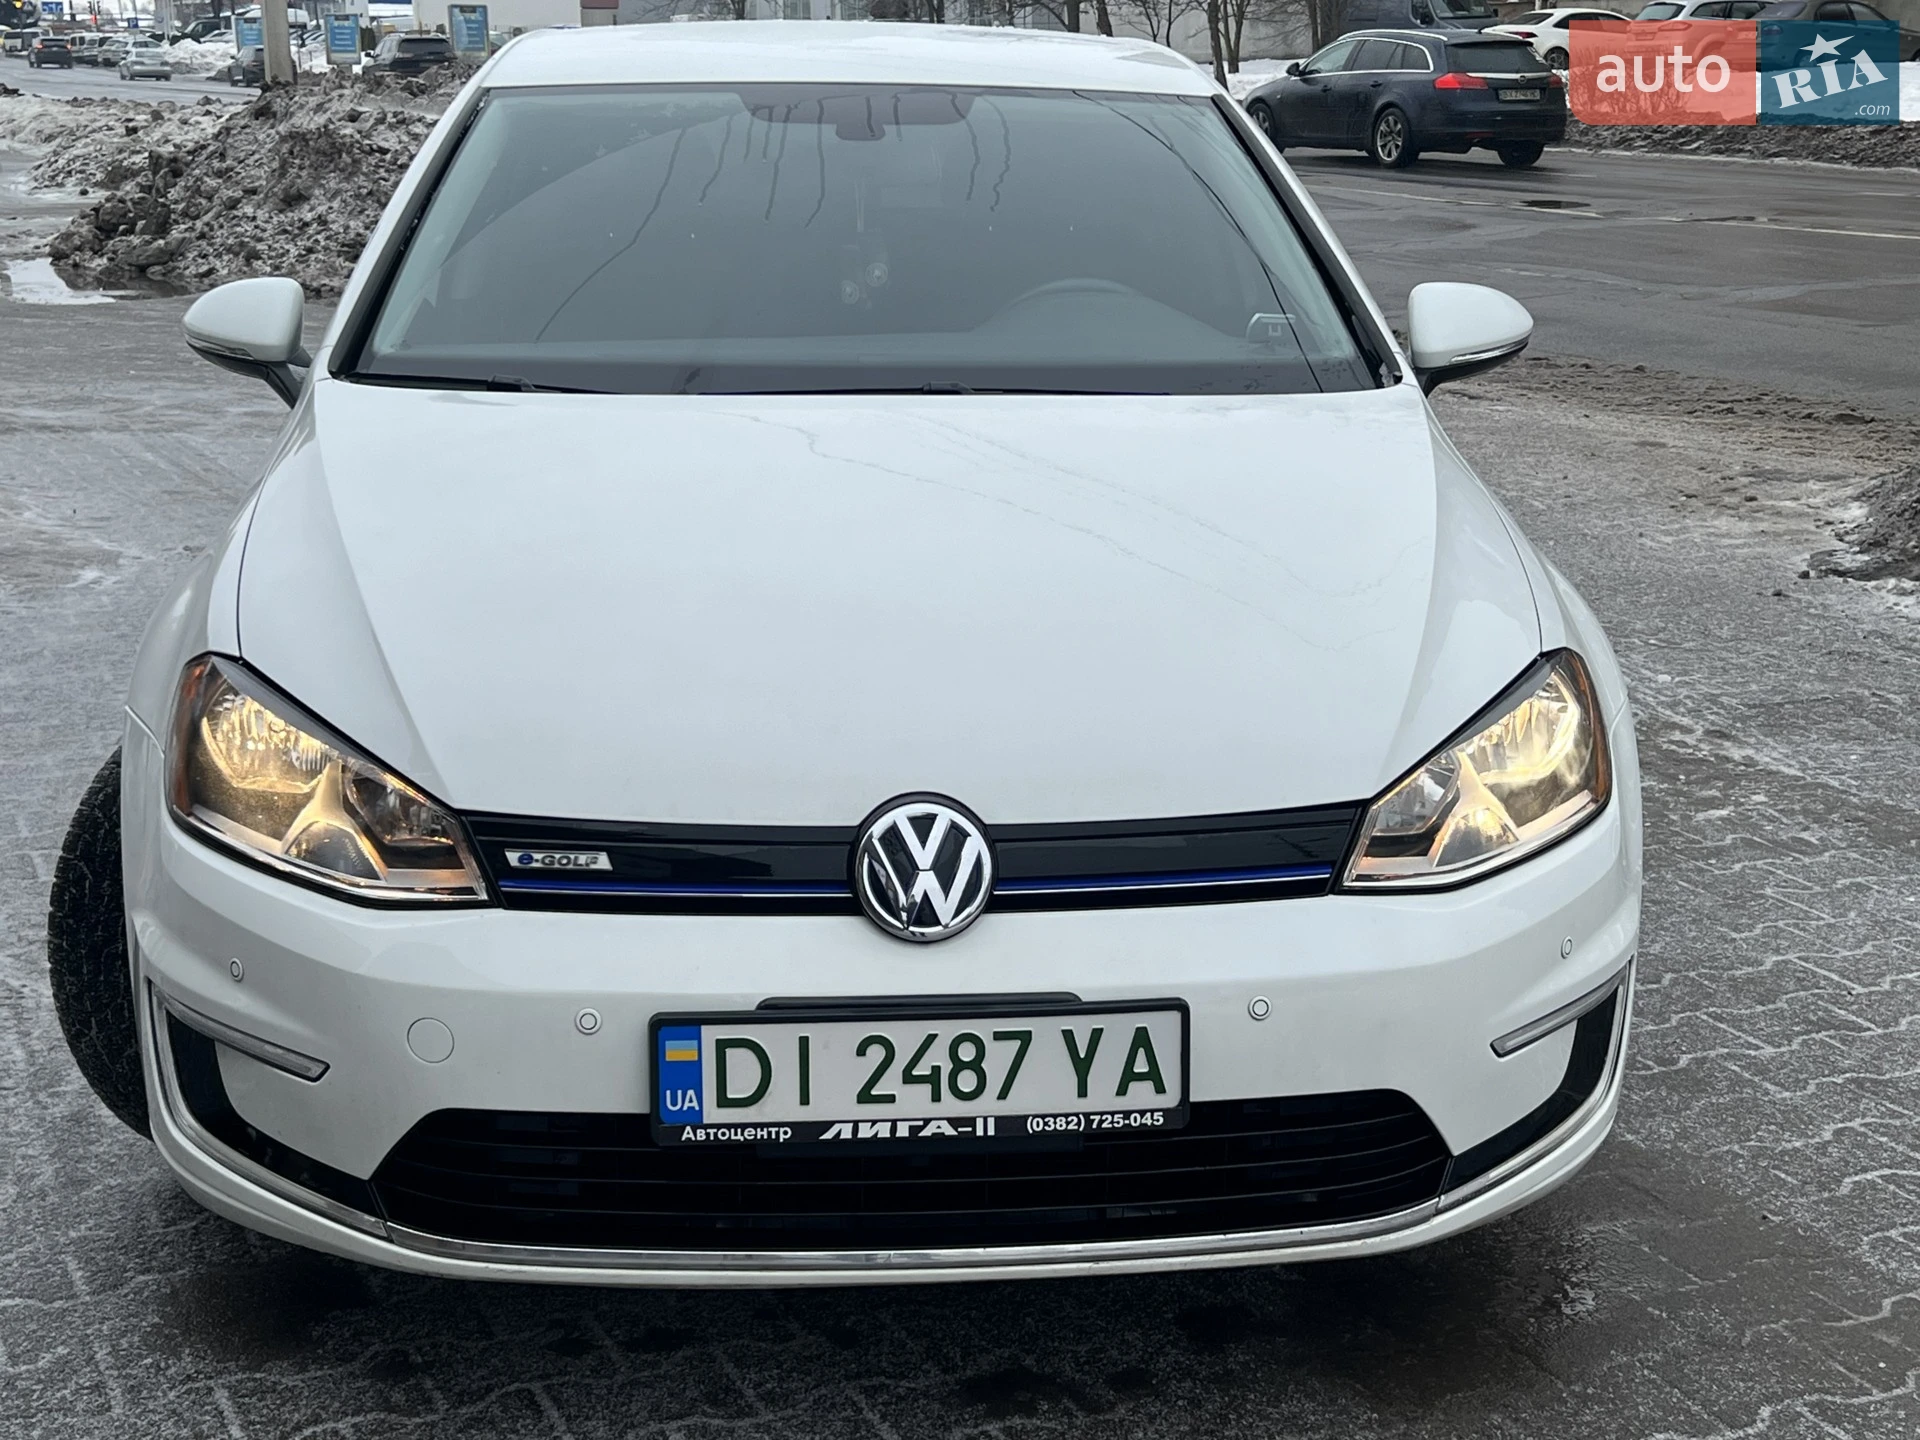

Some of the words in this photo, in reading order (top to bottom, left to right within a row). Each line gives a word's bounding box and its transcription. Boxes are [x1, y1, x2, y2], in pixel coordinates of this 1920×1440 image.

[517, 852, 600, 868] e-GOLF
[715, 1035, 811, 1109] DI
[856, 1029, 1033, 1105] 2487
[1060, 1025, 1168, 1099] YA
[665, 1089, 700, 1112] UA
[681, 1124, 793, 1143] Автоцентр
[1026, 1113, 1085, 1134] (0382)
[1090, 1112, 1165, 1130] 725-045
